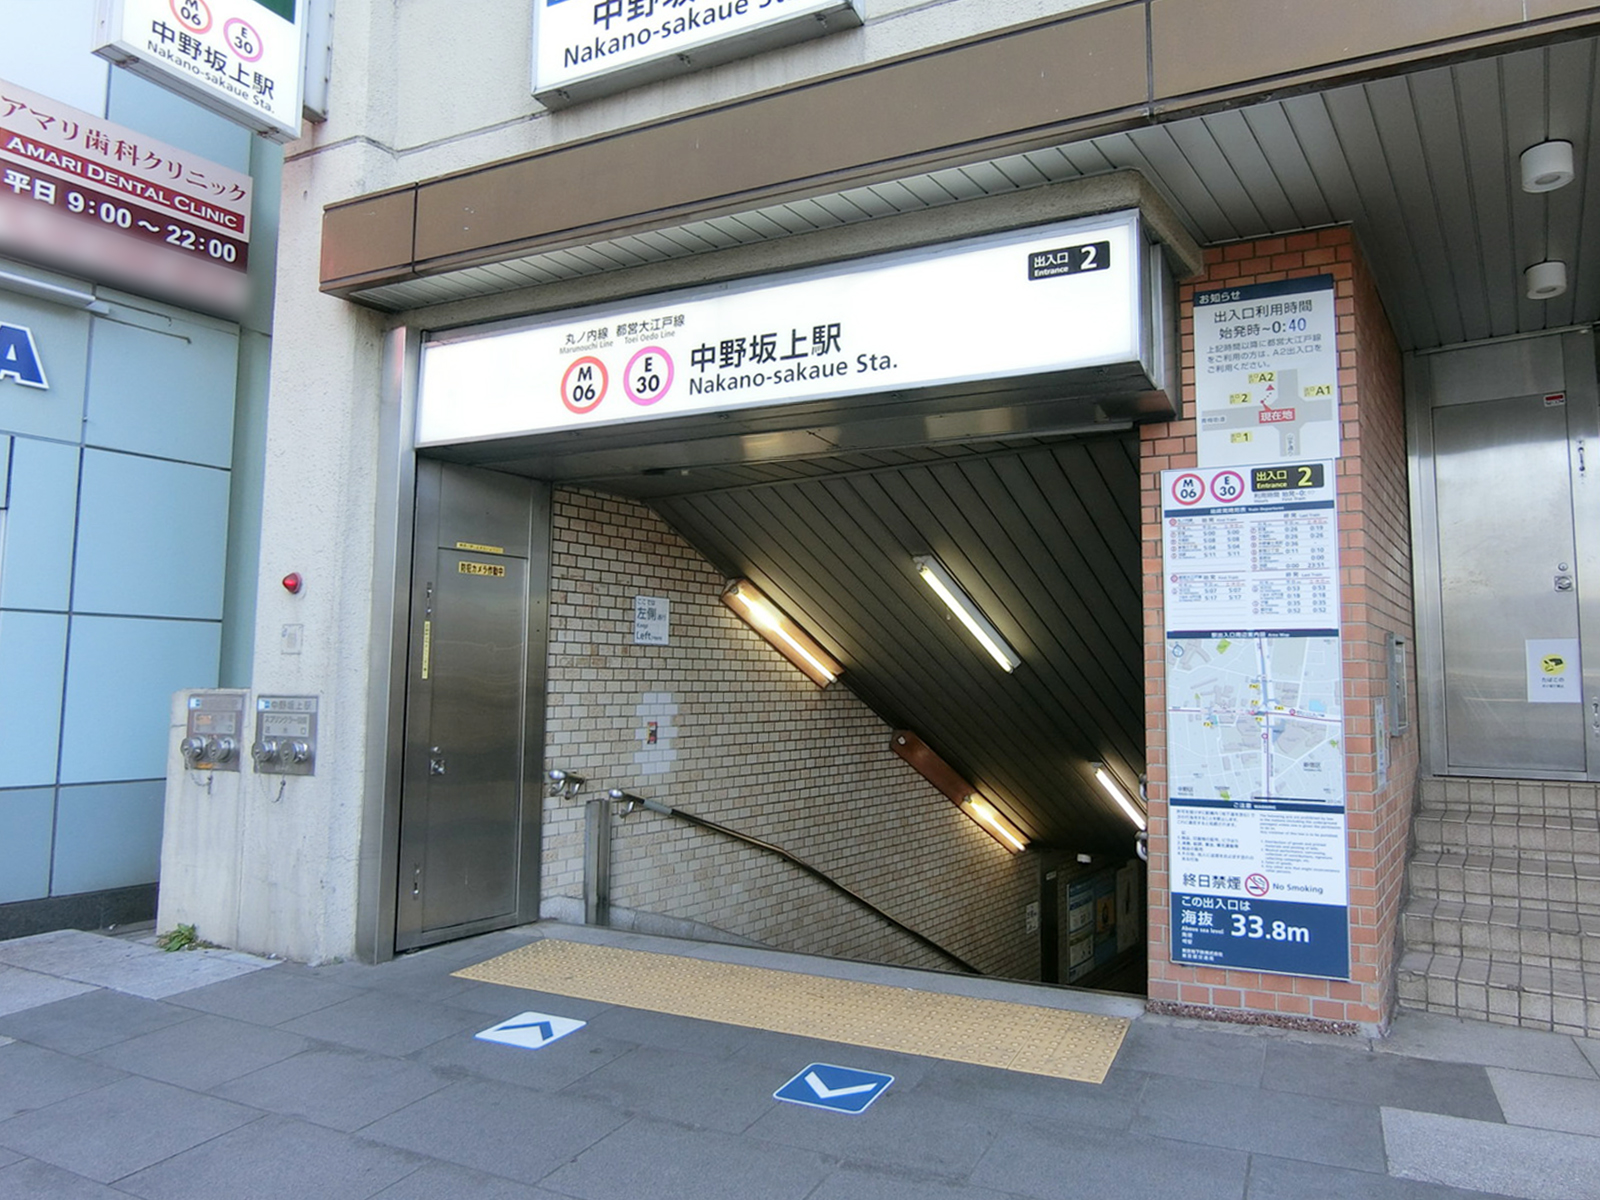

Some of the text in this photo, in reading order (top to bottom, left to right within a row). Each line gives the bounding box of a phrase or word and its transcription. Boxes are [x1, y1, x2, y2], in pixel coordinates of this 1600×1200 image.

[184, 0, 199, 11] M
[180, 6, 202, 26] 06
[593, 0, 696, 31] 中野
[241, 26, 248, 39] E
[563, 0, 749, 68] Nakano-sakaue
[233, 36, 253, 55] 30
[152, 20, 275, 100] 中野坂上駅
[147, 40, 275, 114] Nakano-sakaue Sta.
[1, 96, 246, 202] アマリ歯科クリニック
[4, 169, 56, 205] 平日
[7, 137, 238, 228] AMARI DENTAL CLINIC
[1034, 252, 1069, 268] 出入口
[1080, 245, 1097, 270] 2
[1034, 266, 1069, 277] Entrance
[1199, 291, 1241, 304] お知らせ
[1213, 299, 1313, 324] 出入口利用時間
[565, 314, 685, 345] 丸ノ内線 都営大江戸線
[624, 330, 676, 344] Toei Oedo Line
[559, 340, 614, 355] Marunouchi Line
[690, 322, 842, 374] 中野坂上駅
[644, 357, 653, 372] E
[577, 366, 593, 382] M
[689, 353, 898, 396] Nakano-sakaue Sta.
[1258, 372, 1275, 382] A2
[636, 374, 660, 394] 30
[1315, 386, 1331, 396] A1
[573, 384, 596, 402] 06
[1260, 411, 1293, 422] 現在地
[1182, 479, 1194, 488] M
[1224, 476, 1230, 485] E
[1256, 470, 1288, 482] 出入口
[1297, 466, 1313, 487] 2
[1180, 489, 1197, 499] 06
[1219, 486, 1237, 496] 30
[1256, 481, 1288, 490] Entrance
[636, 630, 651, 640] Left
[1182, 873, 1324, 895] 終日禁煙 No Smoking
[1181, 896, 1251, 912] この出入口は
[1181, 909, 1214, 927] 海抜
[1230, 913, 1310, 943] 33.8m
